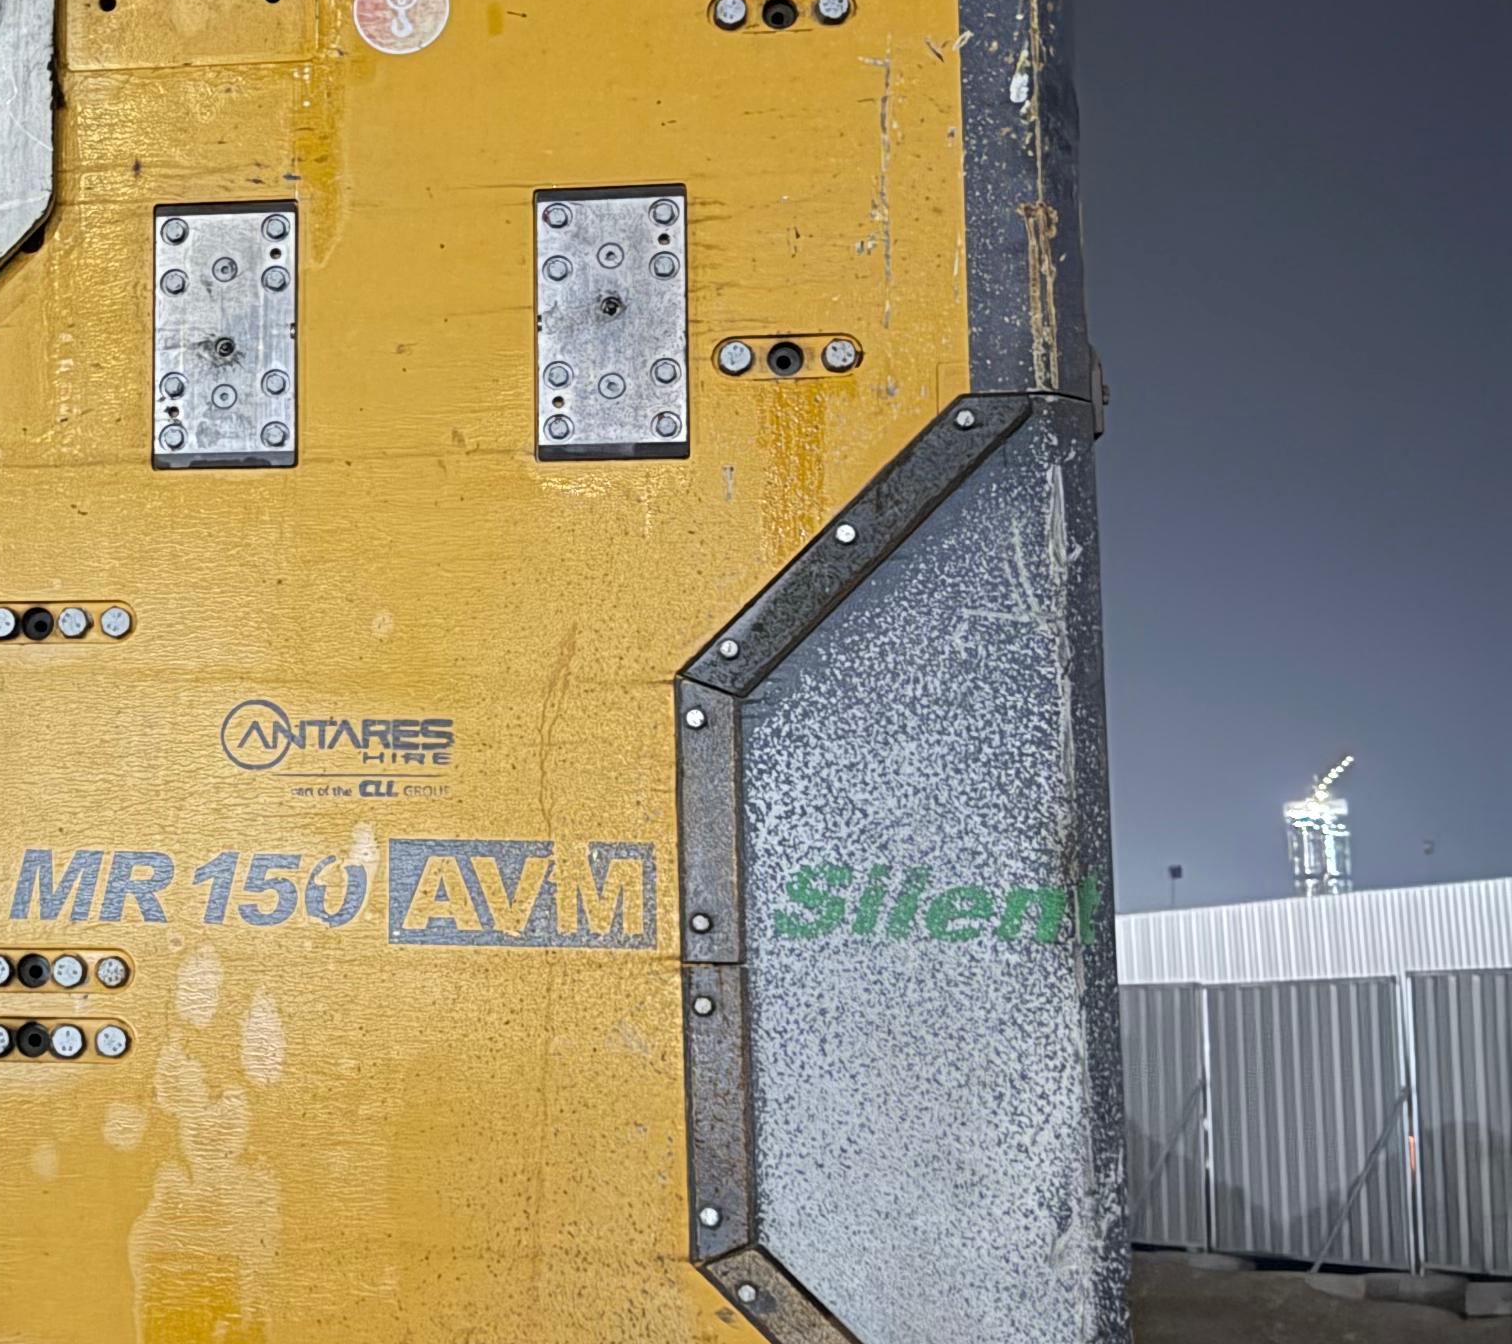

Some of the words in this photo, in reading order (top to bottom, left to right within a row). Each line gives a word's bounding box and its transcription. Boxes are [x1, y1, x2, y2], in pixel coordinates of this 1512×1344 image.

[236, 718, 455, 751] ANTARES
[363, 751, 453, 765] HIRE
[358, 780, 399, 797] CLL
[9, 847, 177, 924] MR
[191, 850, 368, 928] 150
[401, 854, 645, 936] AVM
